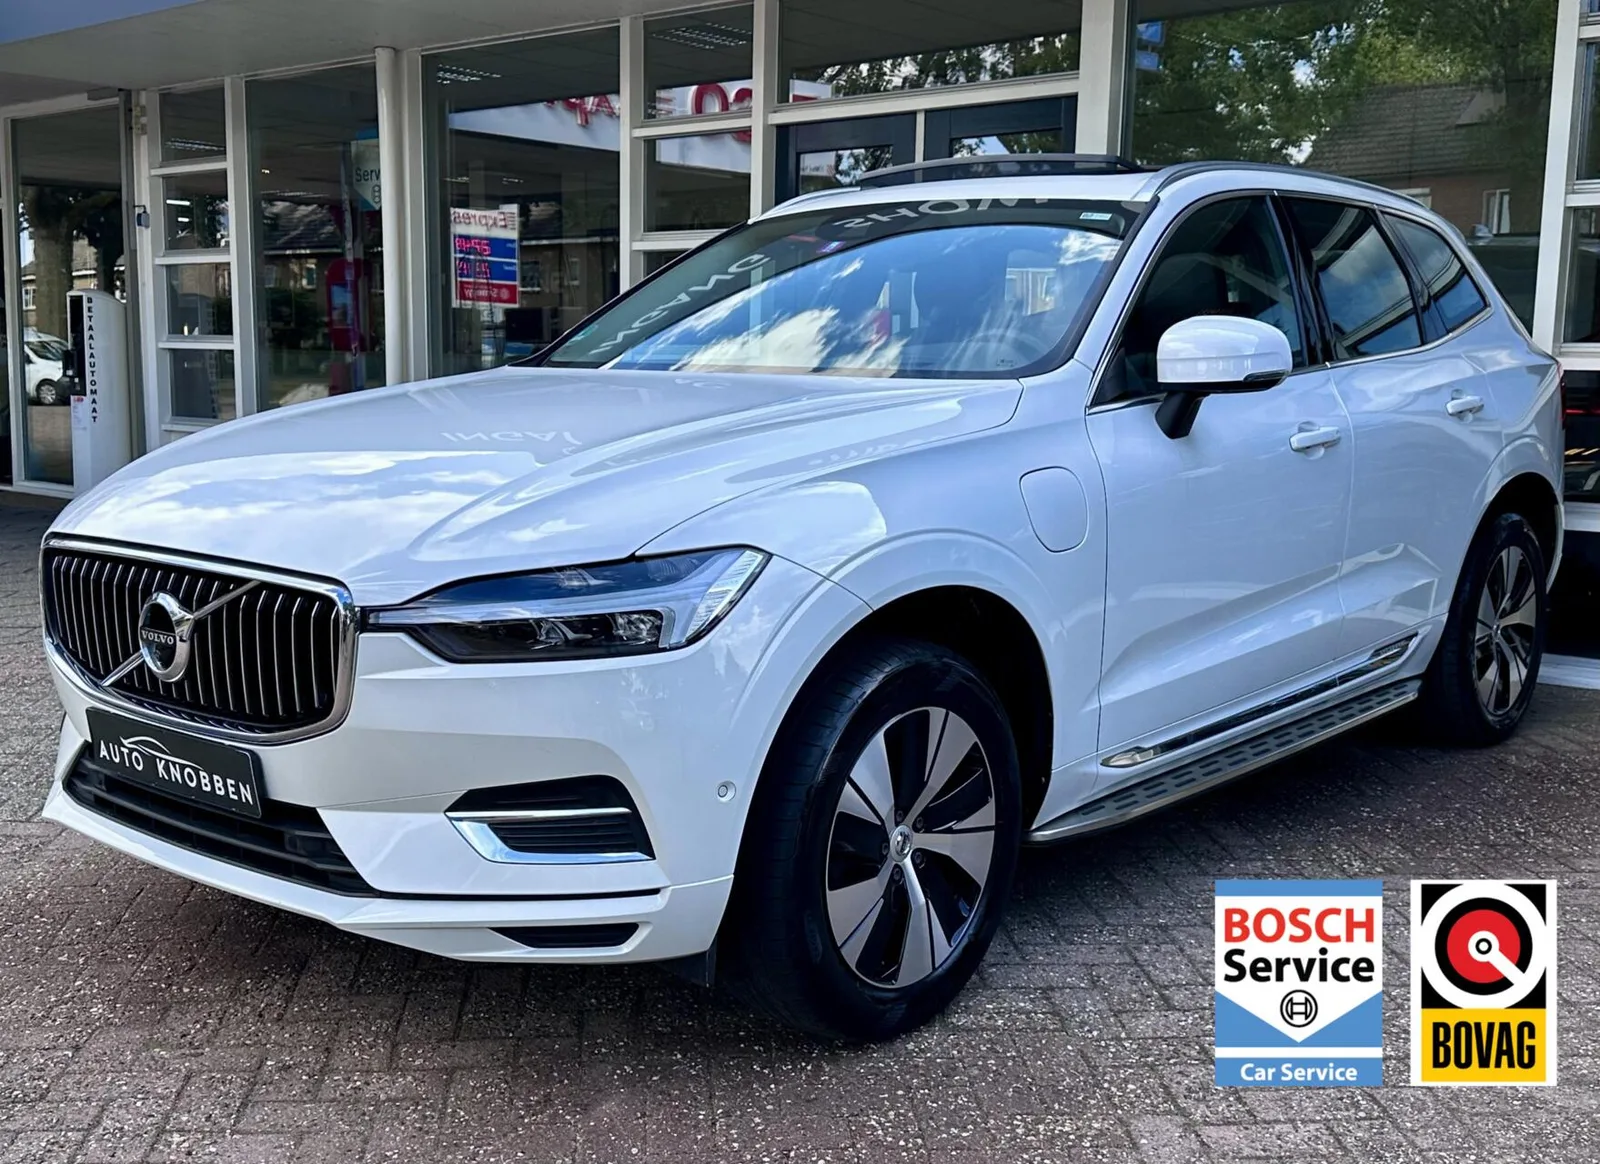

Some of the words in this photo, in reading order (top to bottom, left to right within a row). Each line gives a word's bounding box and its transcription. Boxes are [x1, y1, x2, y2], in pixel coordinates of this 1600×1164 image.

[86, 297, 98, 423] BETAALAUTOMAAT
[141, 629, 175, 646] VOLVO
[99, 739, 144, 772] AUTO
[156, 757, 254, 805] KNOBBEN
